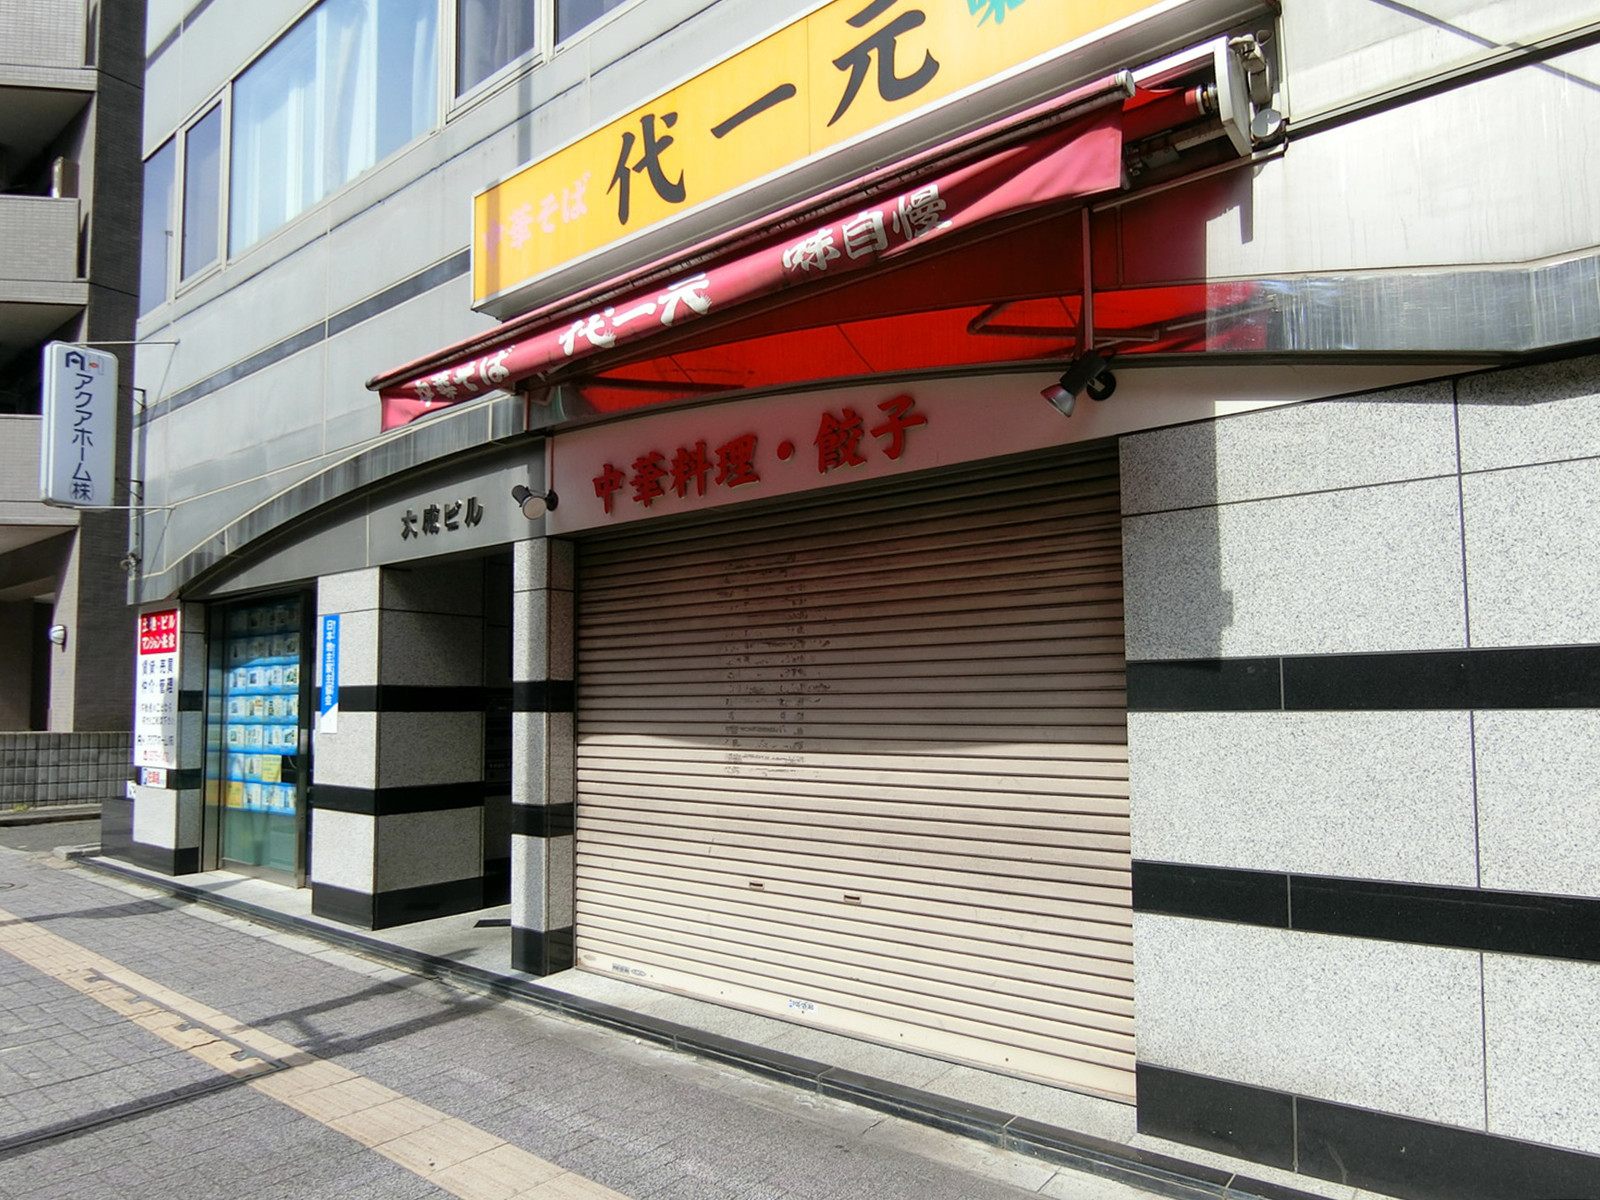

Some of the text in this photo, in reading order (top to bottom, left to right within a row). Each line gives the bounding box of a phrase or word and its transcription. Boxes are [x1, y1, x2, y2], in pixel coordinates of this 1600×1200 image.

[483, 0, 940, 263] 中華そば 代一元
[559, 272, 713, 356] 代一元
[782, 184, 953, 272] 味自慢
[401, 497, 484, 541] 大成ビル
